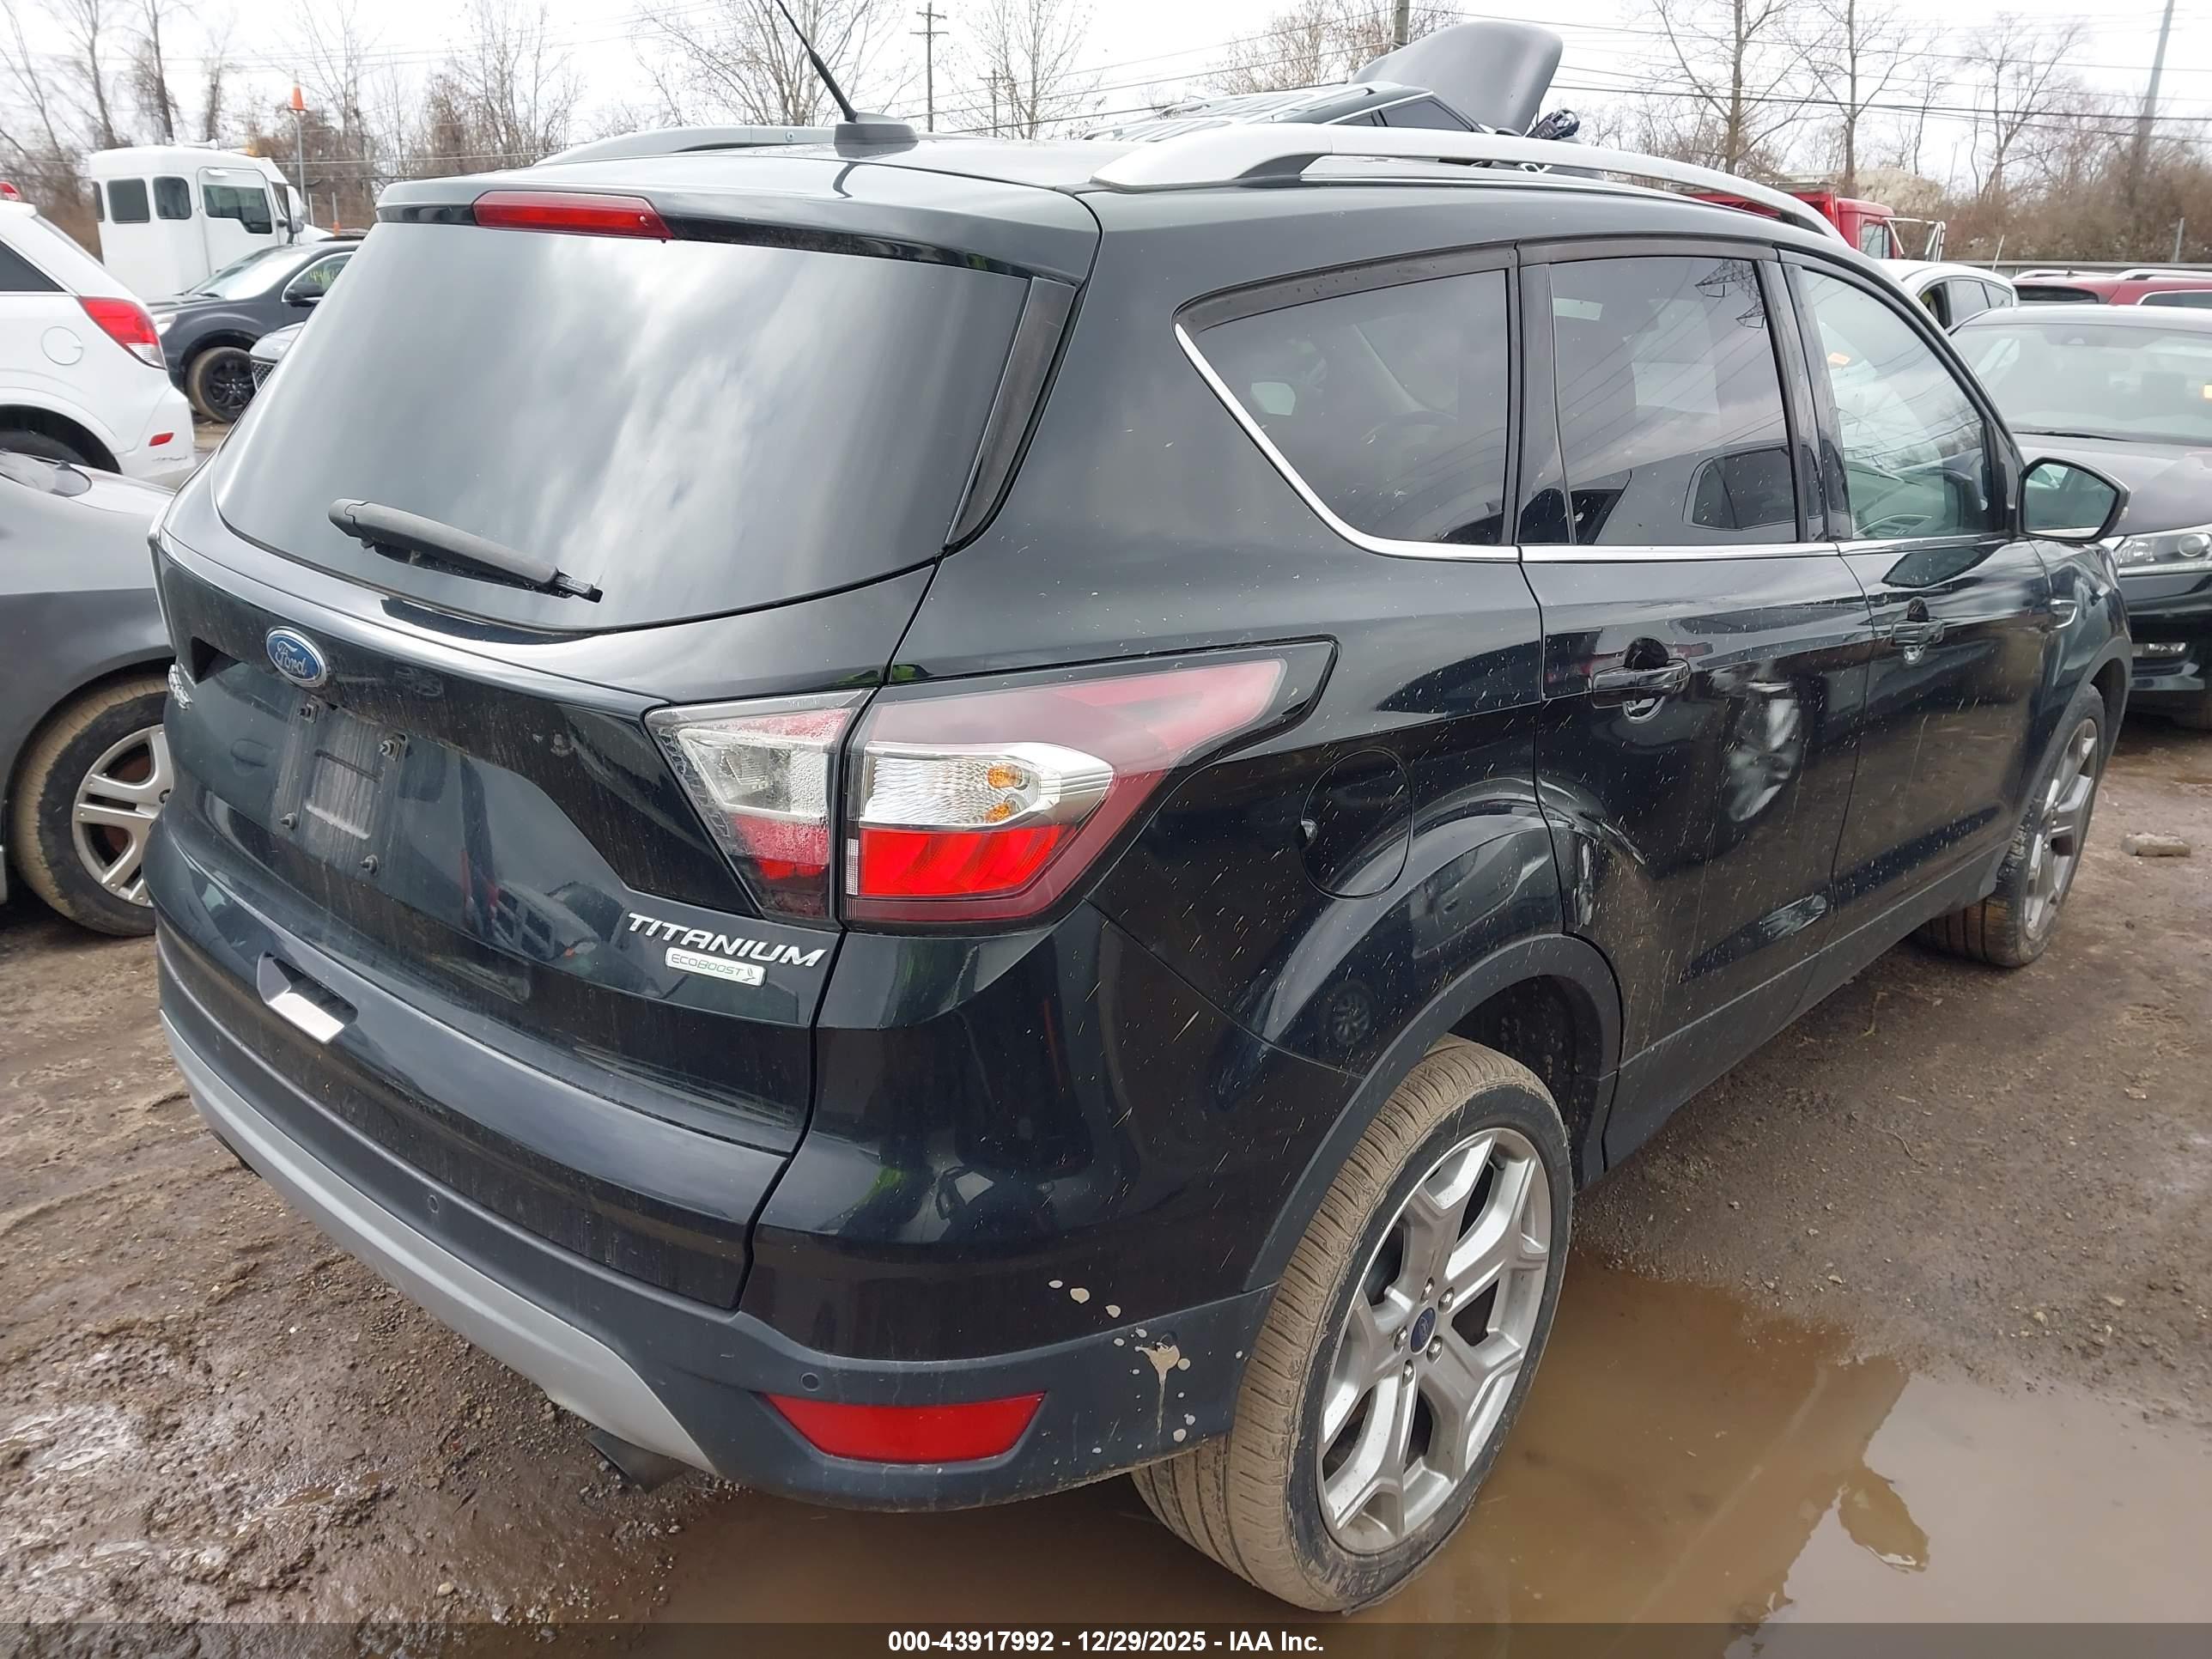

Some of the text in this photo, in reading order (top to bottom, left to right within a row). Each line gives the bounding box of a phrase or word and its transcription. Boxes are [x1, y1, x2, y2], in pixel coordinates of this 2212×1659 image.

[275, 640, 307, 678] Ford
[628, 912, 828, 968] TITANIUM
[671, 953, 744, 977] ECOBOOST
